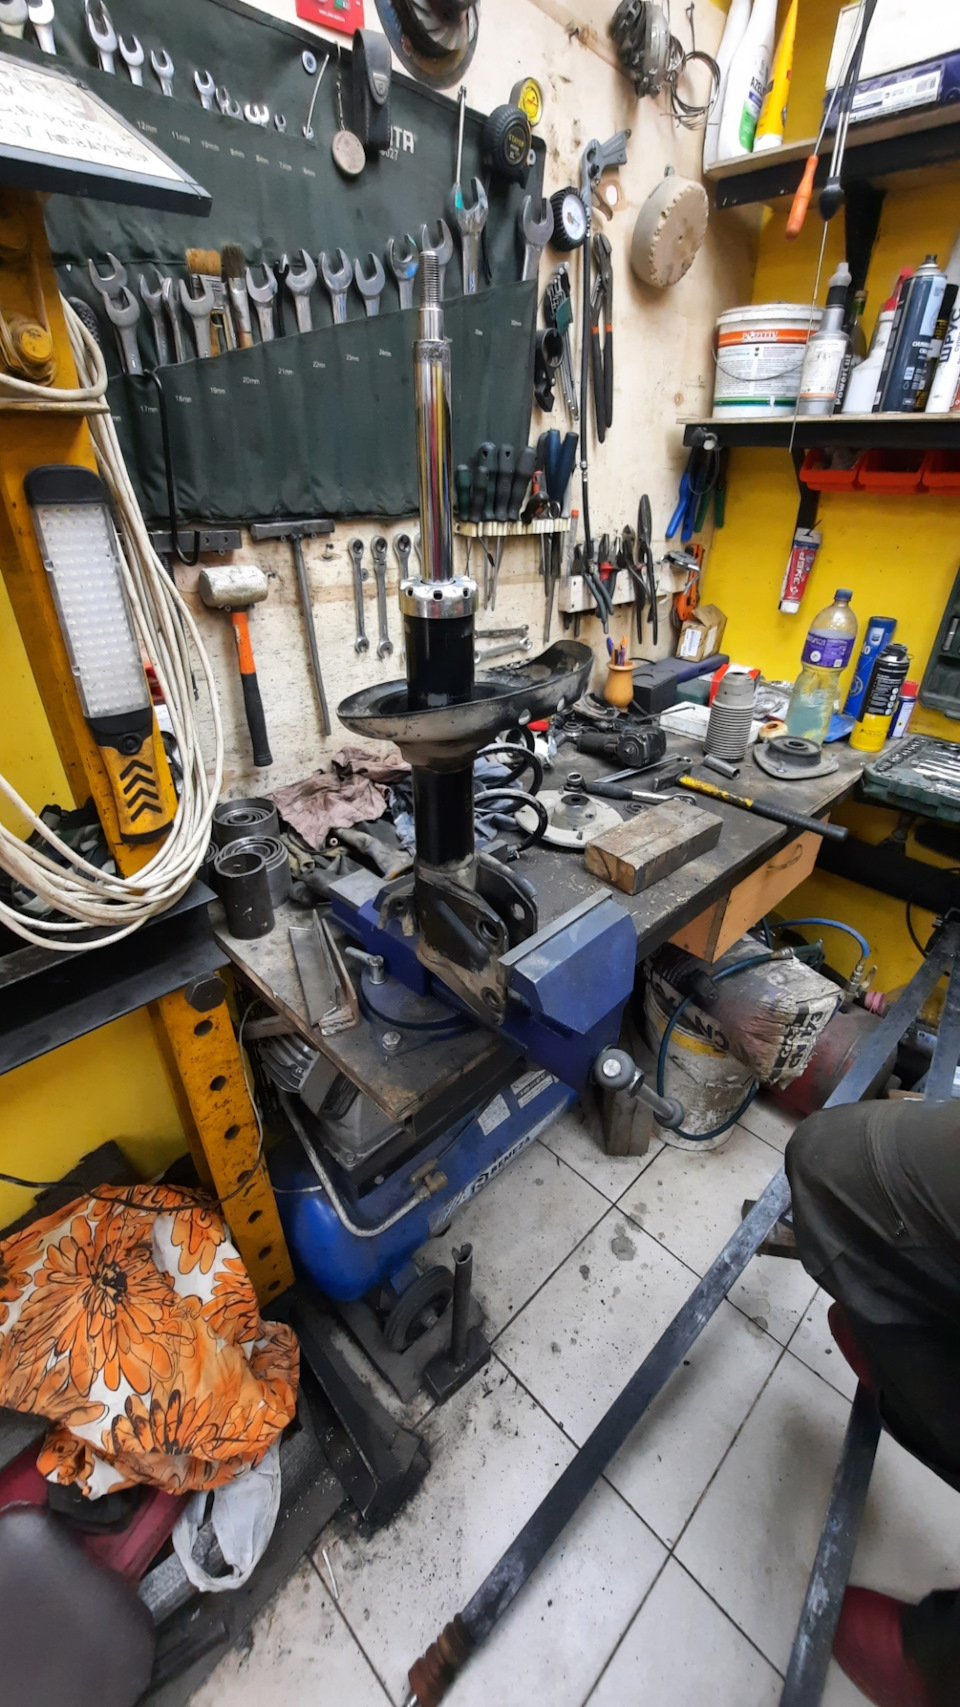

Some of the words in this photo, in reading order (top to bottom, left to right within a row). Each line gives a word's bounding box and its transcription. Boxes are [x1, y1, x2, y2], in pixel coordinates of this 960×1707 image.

[137, 120, 158, 134] 12mm
[172, 130, 191, 144] 11mm
[242, 376, 261, 385] 20mm
[835, 353, 852, 405] PowerCut
[209, 386, 226, 395] 19mm
[140, 404, 159, 413] 17mm
[793, 552, 806, 585] ЗУБР
[490, 1136, 530, 1174] REMEZA
